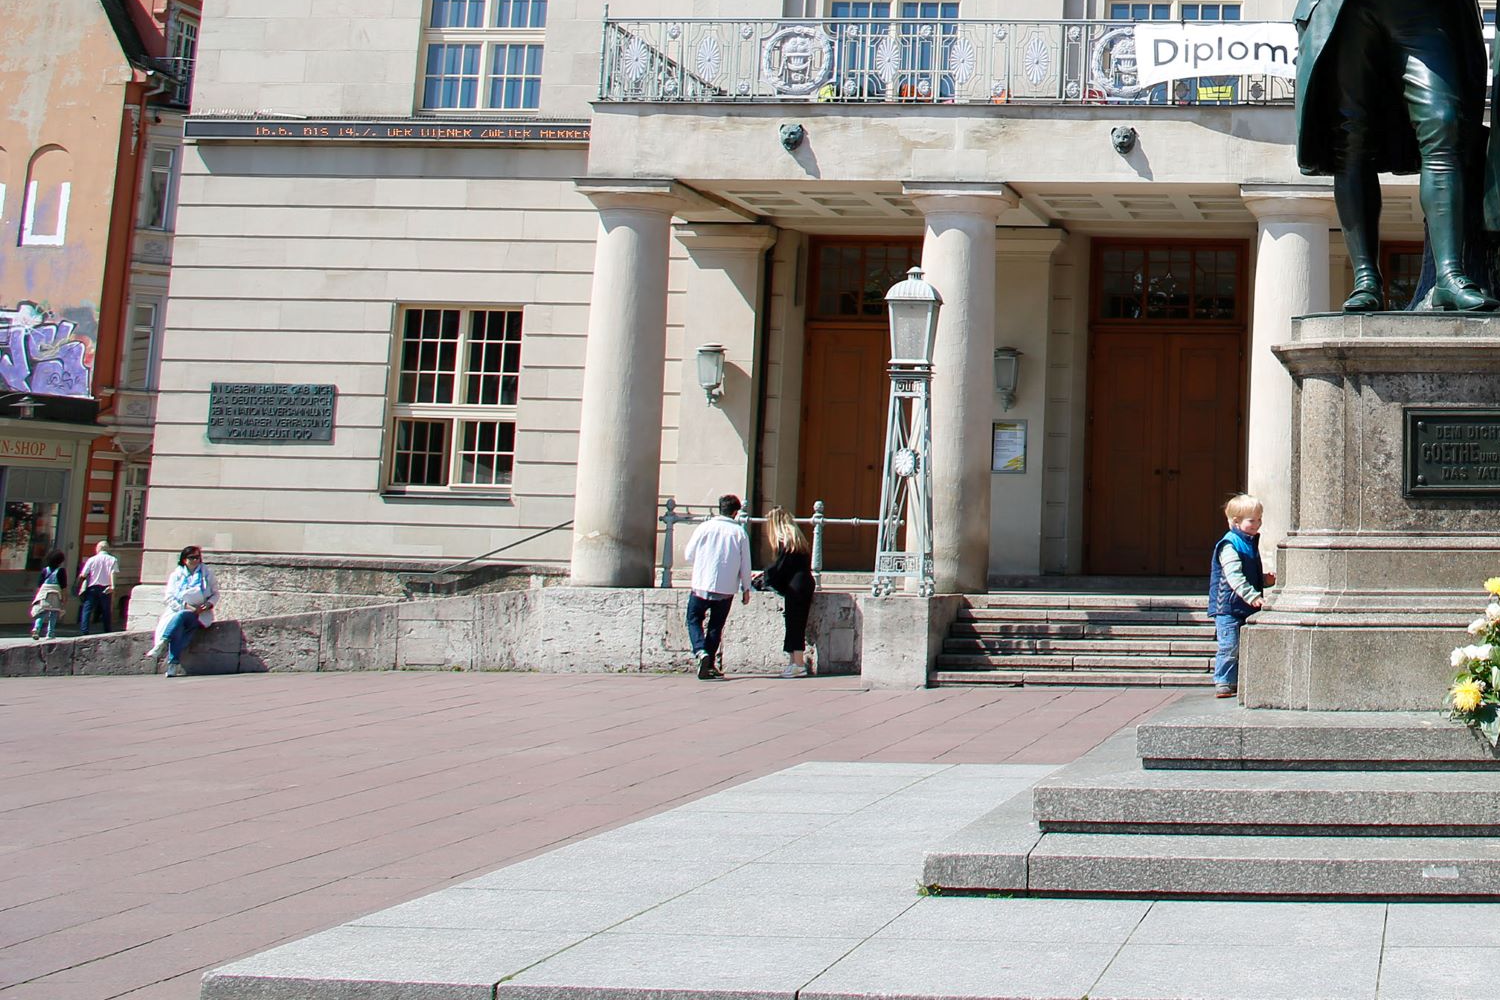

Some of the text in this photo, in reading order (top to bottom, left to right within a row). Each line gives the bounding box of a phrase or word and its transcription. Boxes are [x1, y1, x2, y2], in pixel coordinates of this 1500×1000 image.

[1153, 36, 1300, 69] Diplom
[225, 385, 256, 395] DIESEM
[259, 385, 288, 395] HAUSE
[232, 396, 274, 406] DEUTSCHE
[300, 396, 333, 406] DURCH
[1435, 425, 1463, 440] DEM
[0, 440, 46, 456] N-SHOP
[1421, 442, 1480, 464] GOETHE
[1441, 466, 1469, 481] DAS
